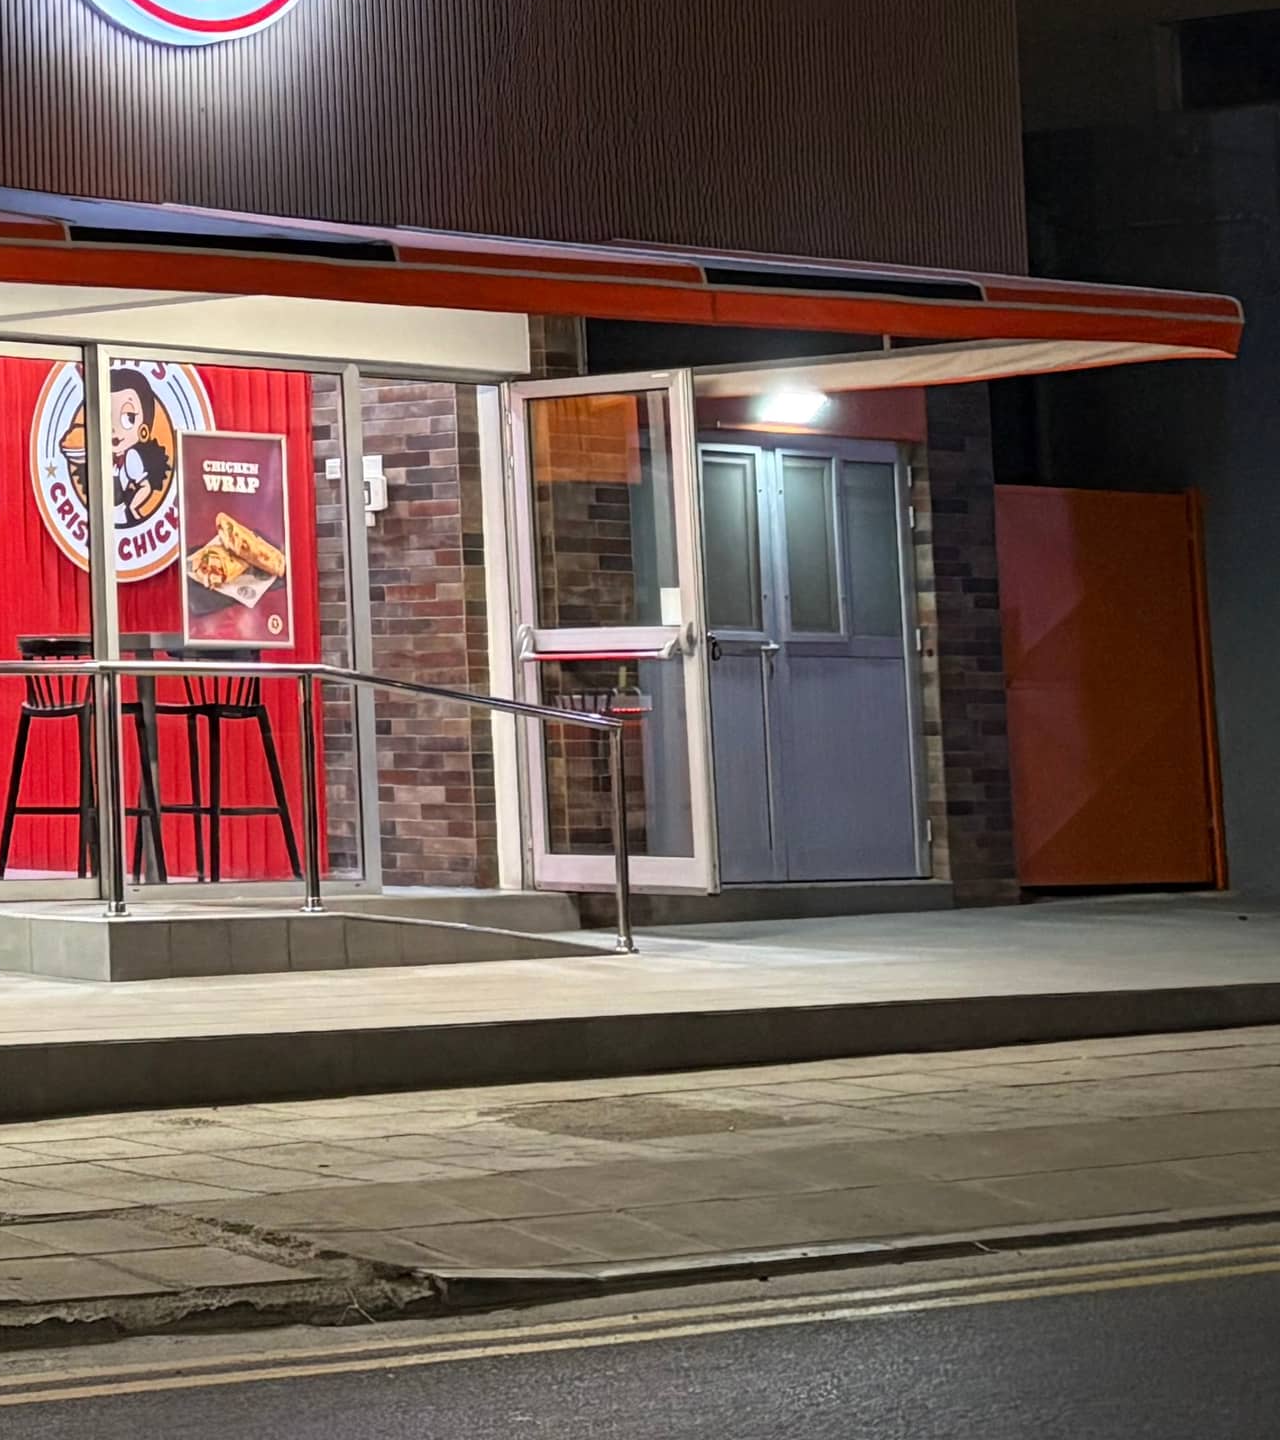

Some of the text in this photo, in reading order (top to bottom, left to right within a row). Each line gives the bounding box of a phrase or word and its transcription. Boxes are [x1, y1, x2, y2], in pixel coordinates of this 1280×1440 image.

[202, 460, 260, 475] CHICKEN
[202, 474, 260, 494] WRAP
[50, 482, 180, 561] CRIS CHICK
